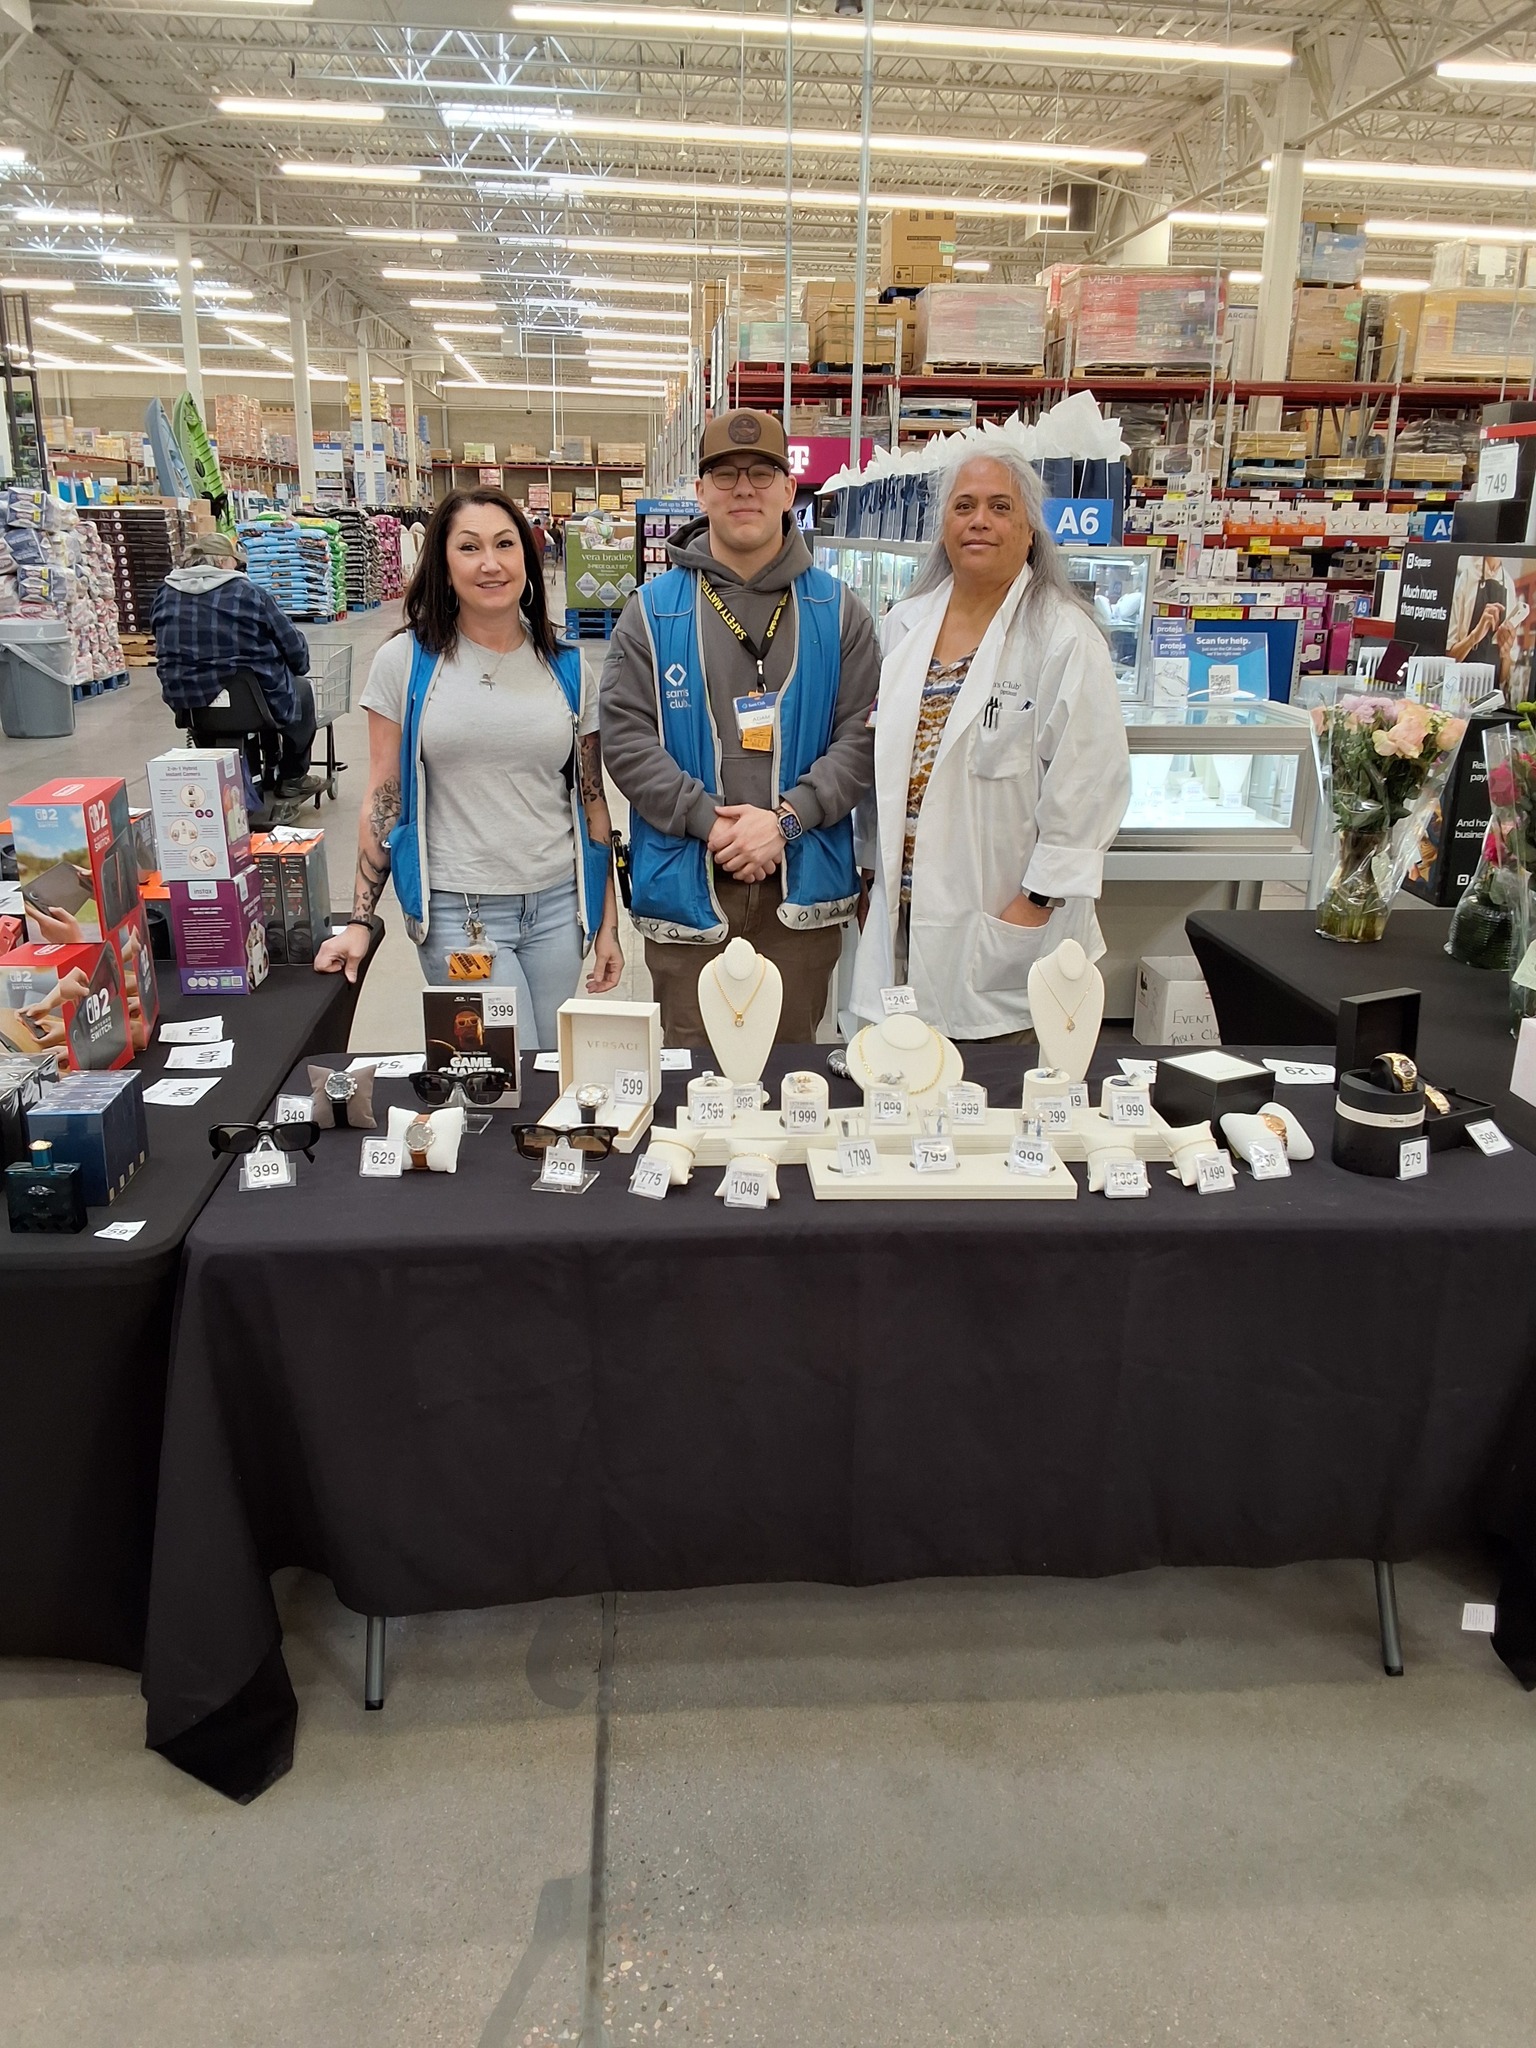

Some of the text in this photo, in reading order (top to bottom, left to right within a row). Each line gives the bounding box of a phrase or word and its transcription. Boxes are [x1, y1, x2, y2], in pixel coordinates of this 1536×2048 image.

[788, 445, 810, 474] T
[1485, 473, 1507, 494] $749
[1056, 507, 1099, 535] A6
[581, 553, 634, 562] vera bradley
[1414, 556, 1431, 569] Square
[1402, 584, 1438, 600] Much more
[1357, 600, 1367, 613] A9
[1400, 602, 1447, 621] than payments
[720, 608, 747, 640] SAFETY
[1157, 626, 1183, 634] proteja
[1159, 642, 1186, 651] proteja
[1196, 637, 1251, 646] Scan for help.
[1002, 680, 1020, 689] Club
[669, 698, 688, 709] club
[1456, 818, 1475, 827] And
[94, 837, 111, 852] SWITCH
[488, 1005, 514, 1017] $399
[1173, 1009, 1211, 1024] EVENT
[90, 1021, 113, 1042] SWITCH
[1201, 1029, 1220, 1040] Clo
[450, 1057, 492, 1068] GAME
[281, 1109, 305, 1122] $349
[789, 1110, 817, 1123] $1999
[368, 1151, 396, 1165] $629
[249, 1162, 280, 1178] $399
[547, 1160, 576, 1176] $299
[730, 1179, 760, 1196] $1049
